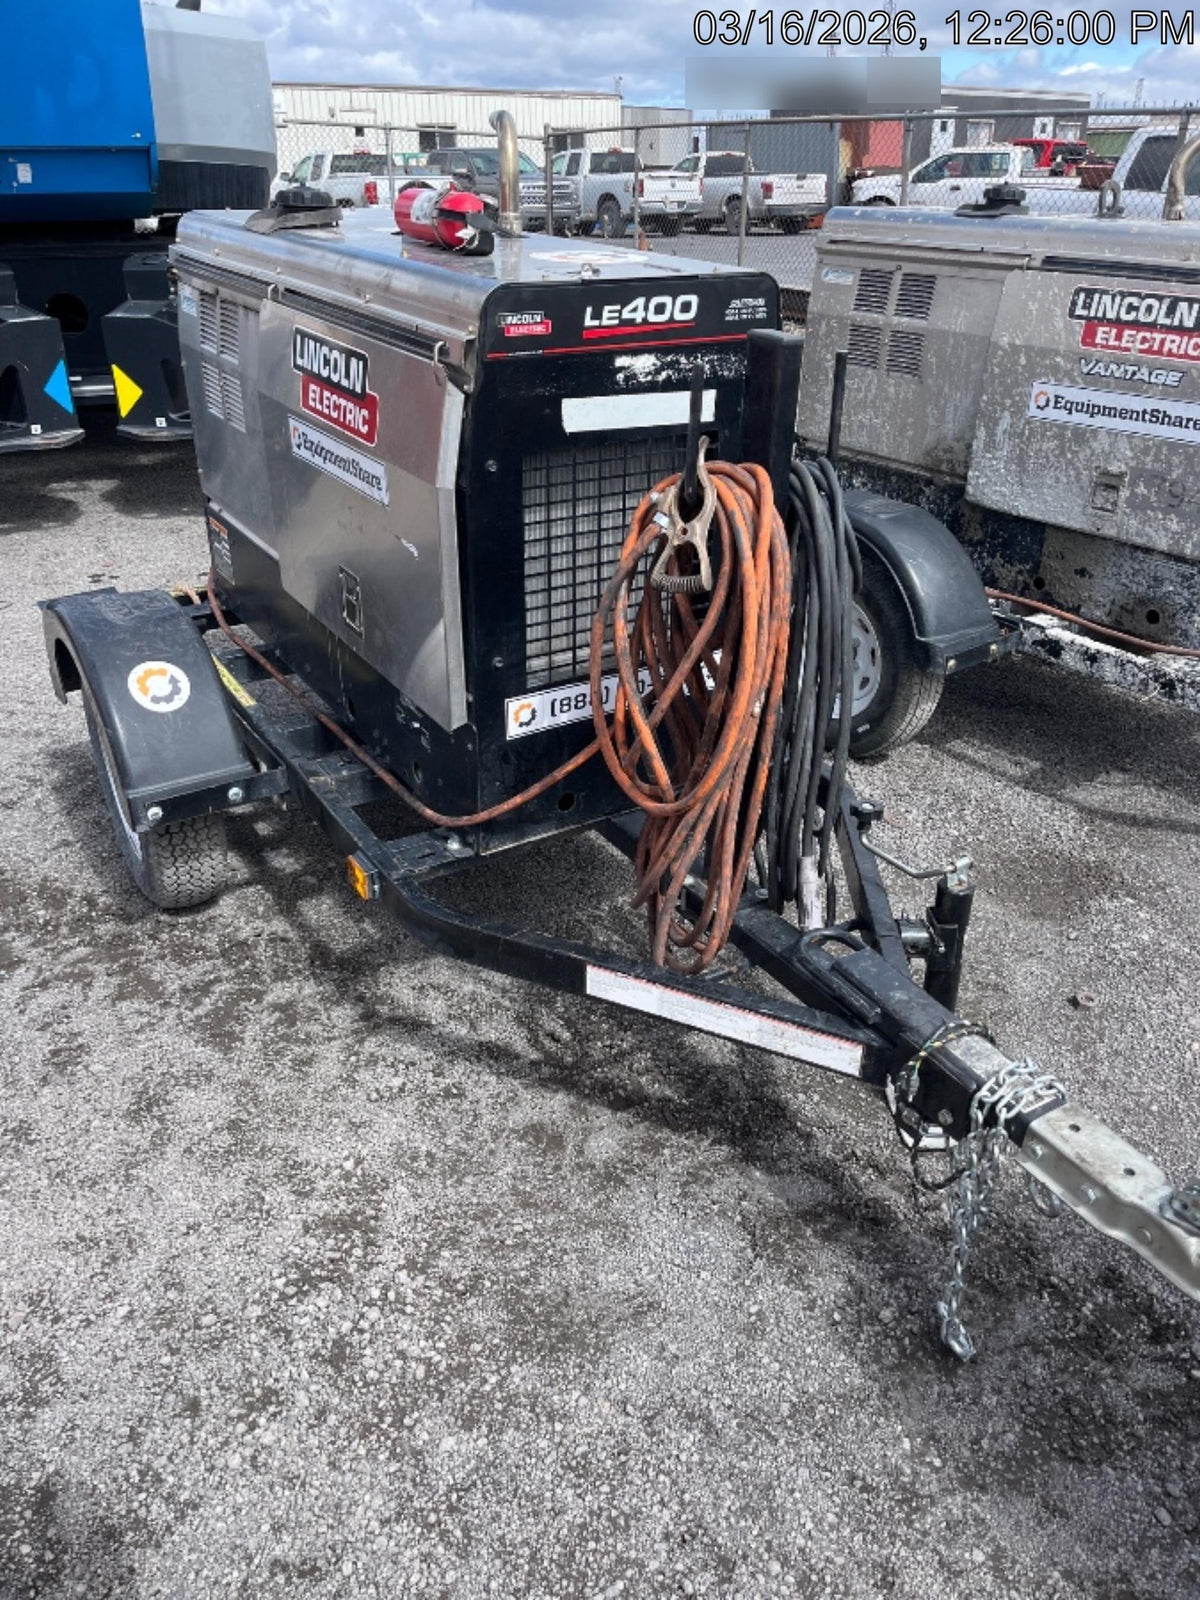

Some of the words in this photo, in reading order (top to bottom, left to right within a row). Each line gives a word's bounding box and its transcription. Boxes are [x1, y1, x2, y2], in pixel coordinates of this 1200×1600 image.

[499, 312, 543, 325] LINCOLN
[583, 294, 699, 327] LE400
[1074, 292, 1200, 328] LINCOLN
[1095, 326, 1200, 357] ELECTRIC
[295, 333, 364, 394] LINCOLN
[1079, 357, 1185, 388] VANTAGE
[308, 382, 369, 435] ELECTRIC
[1052, 394, 1200, 431] EquipmentShare
[301, 431, 383, 492] EquipmentShare
